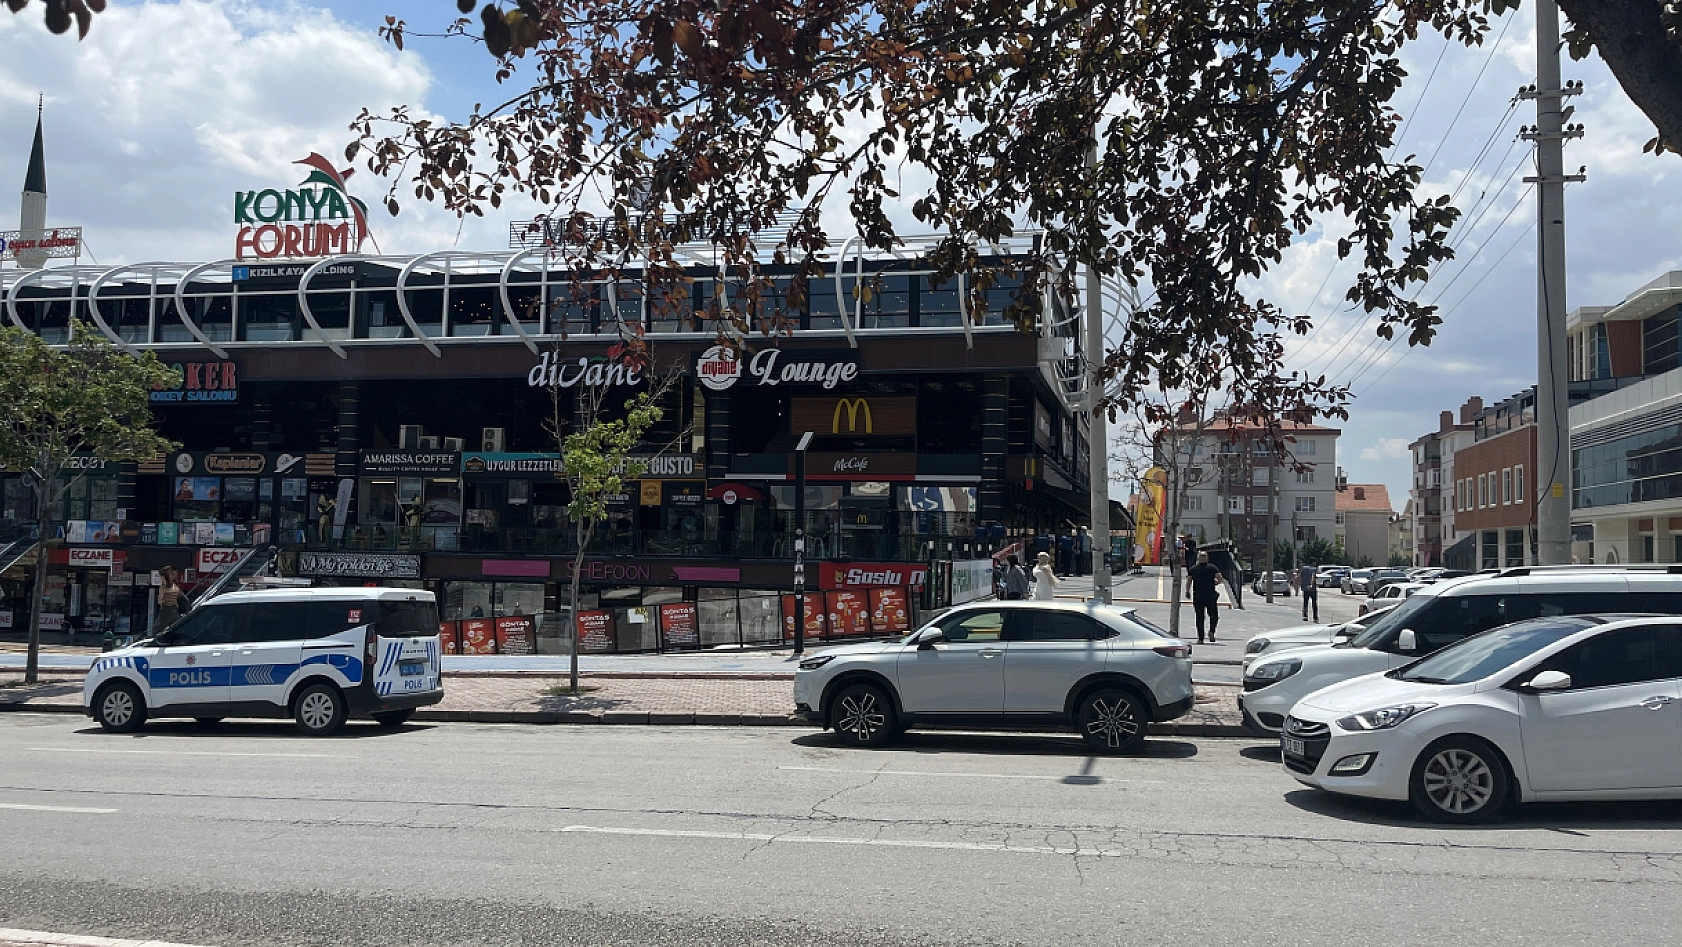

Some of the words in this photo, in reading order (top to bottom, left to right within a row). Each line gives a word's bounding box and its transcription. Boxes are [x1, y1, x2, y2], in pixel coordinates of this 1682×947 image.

[235, 187, 348, 224] KONYA
[236, 222, 348, 260] FORUM
[314, 266, 355, 275] OLDING
[152, 362, 237, 390] OKER
[528, 350, 642, 387] divane
[749, 348, 859, 389] Lounge
[150, 391, 184, 402] OKEY
[186, 391, 237, 401] SALONU
[363, 453, 414, 465] AMARISSA
[415, 453, 455, 465] COFFEE
[487, 460, 517, 472] UYGUR
[651, 456, 693, 475] GUSTO
[71, 550, 111, 560] ECZANE
[846, 568, 903, 585] Soslu
[169, 667, 212, 685] POLİS
